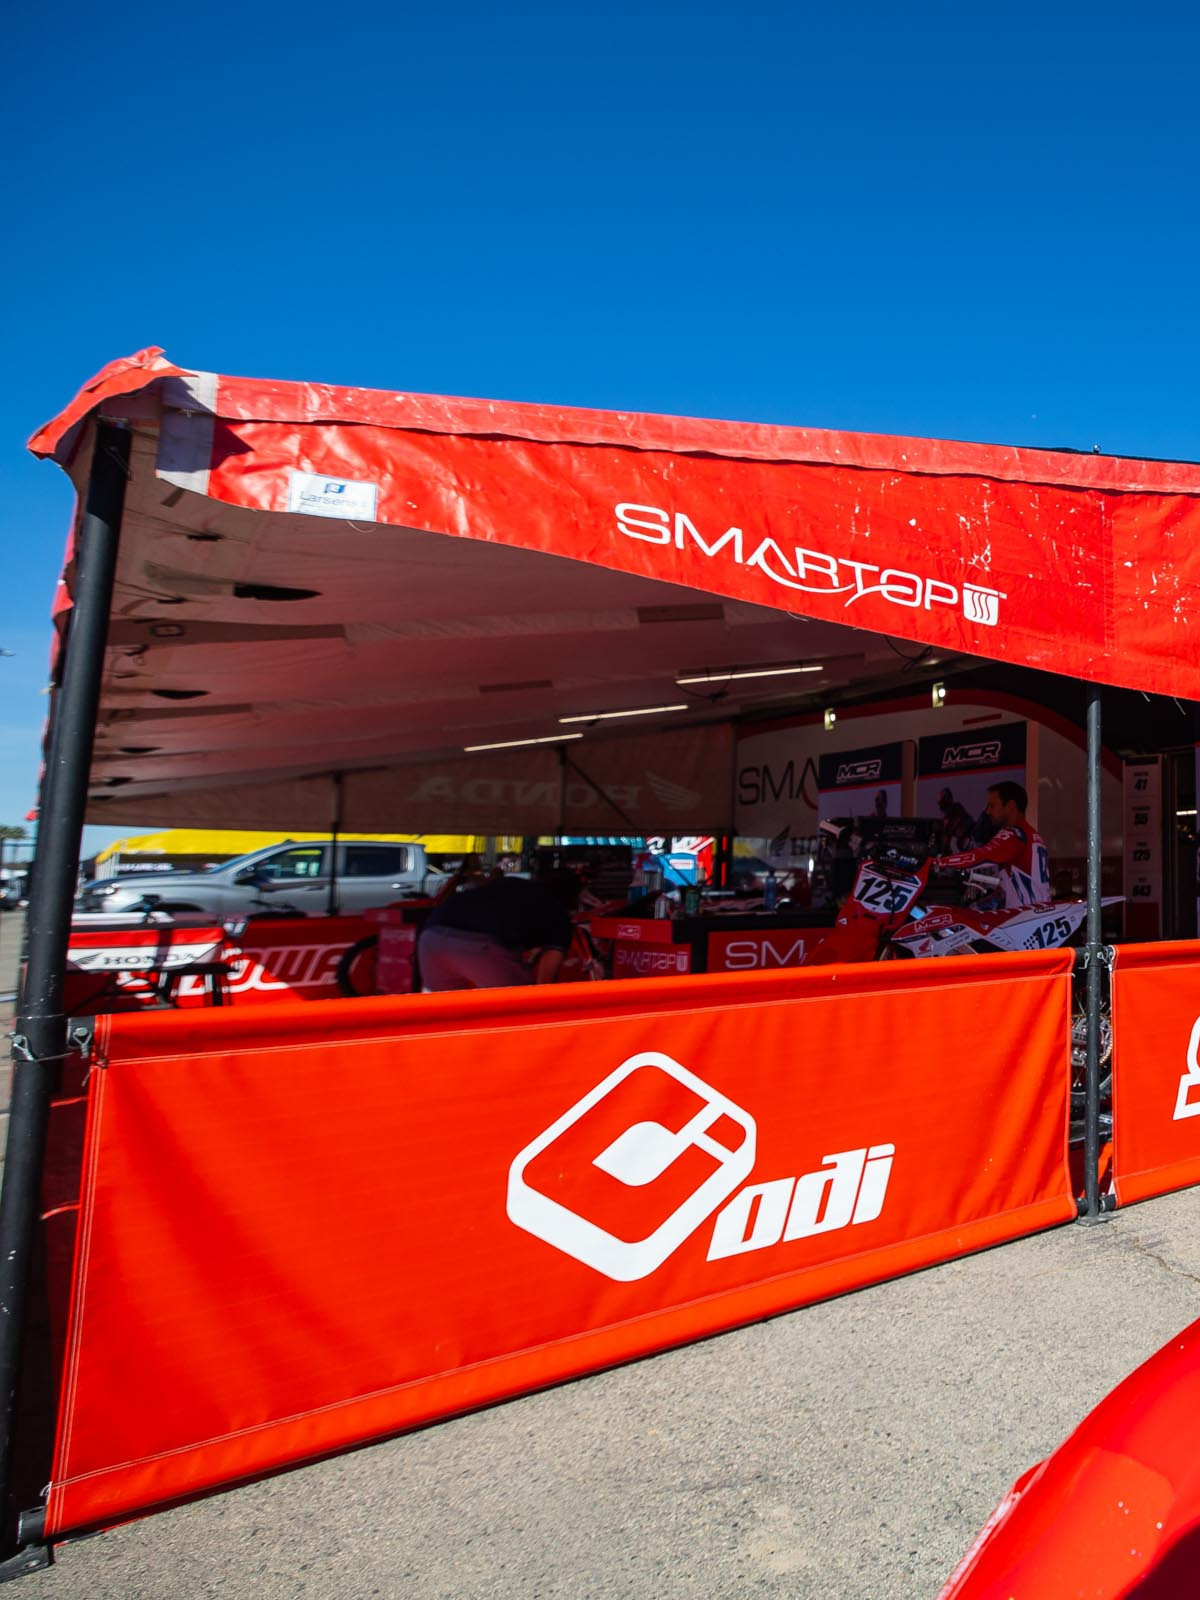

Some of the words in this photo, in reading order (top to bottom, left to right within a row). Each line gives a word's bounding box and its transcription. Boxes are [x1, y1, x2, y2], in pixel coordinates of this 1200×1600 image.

[614, 502, 959, 611] SMARTOP
[1033, 916, 1072, 949] 125
[705, 1142, 896, 1262] odi
